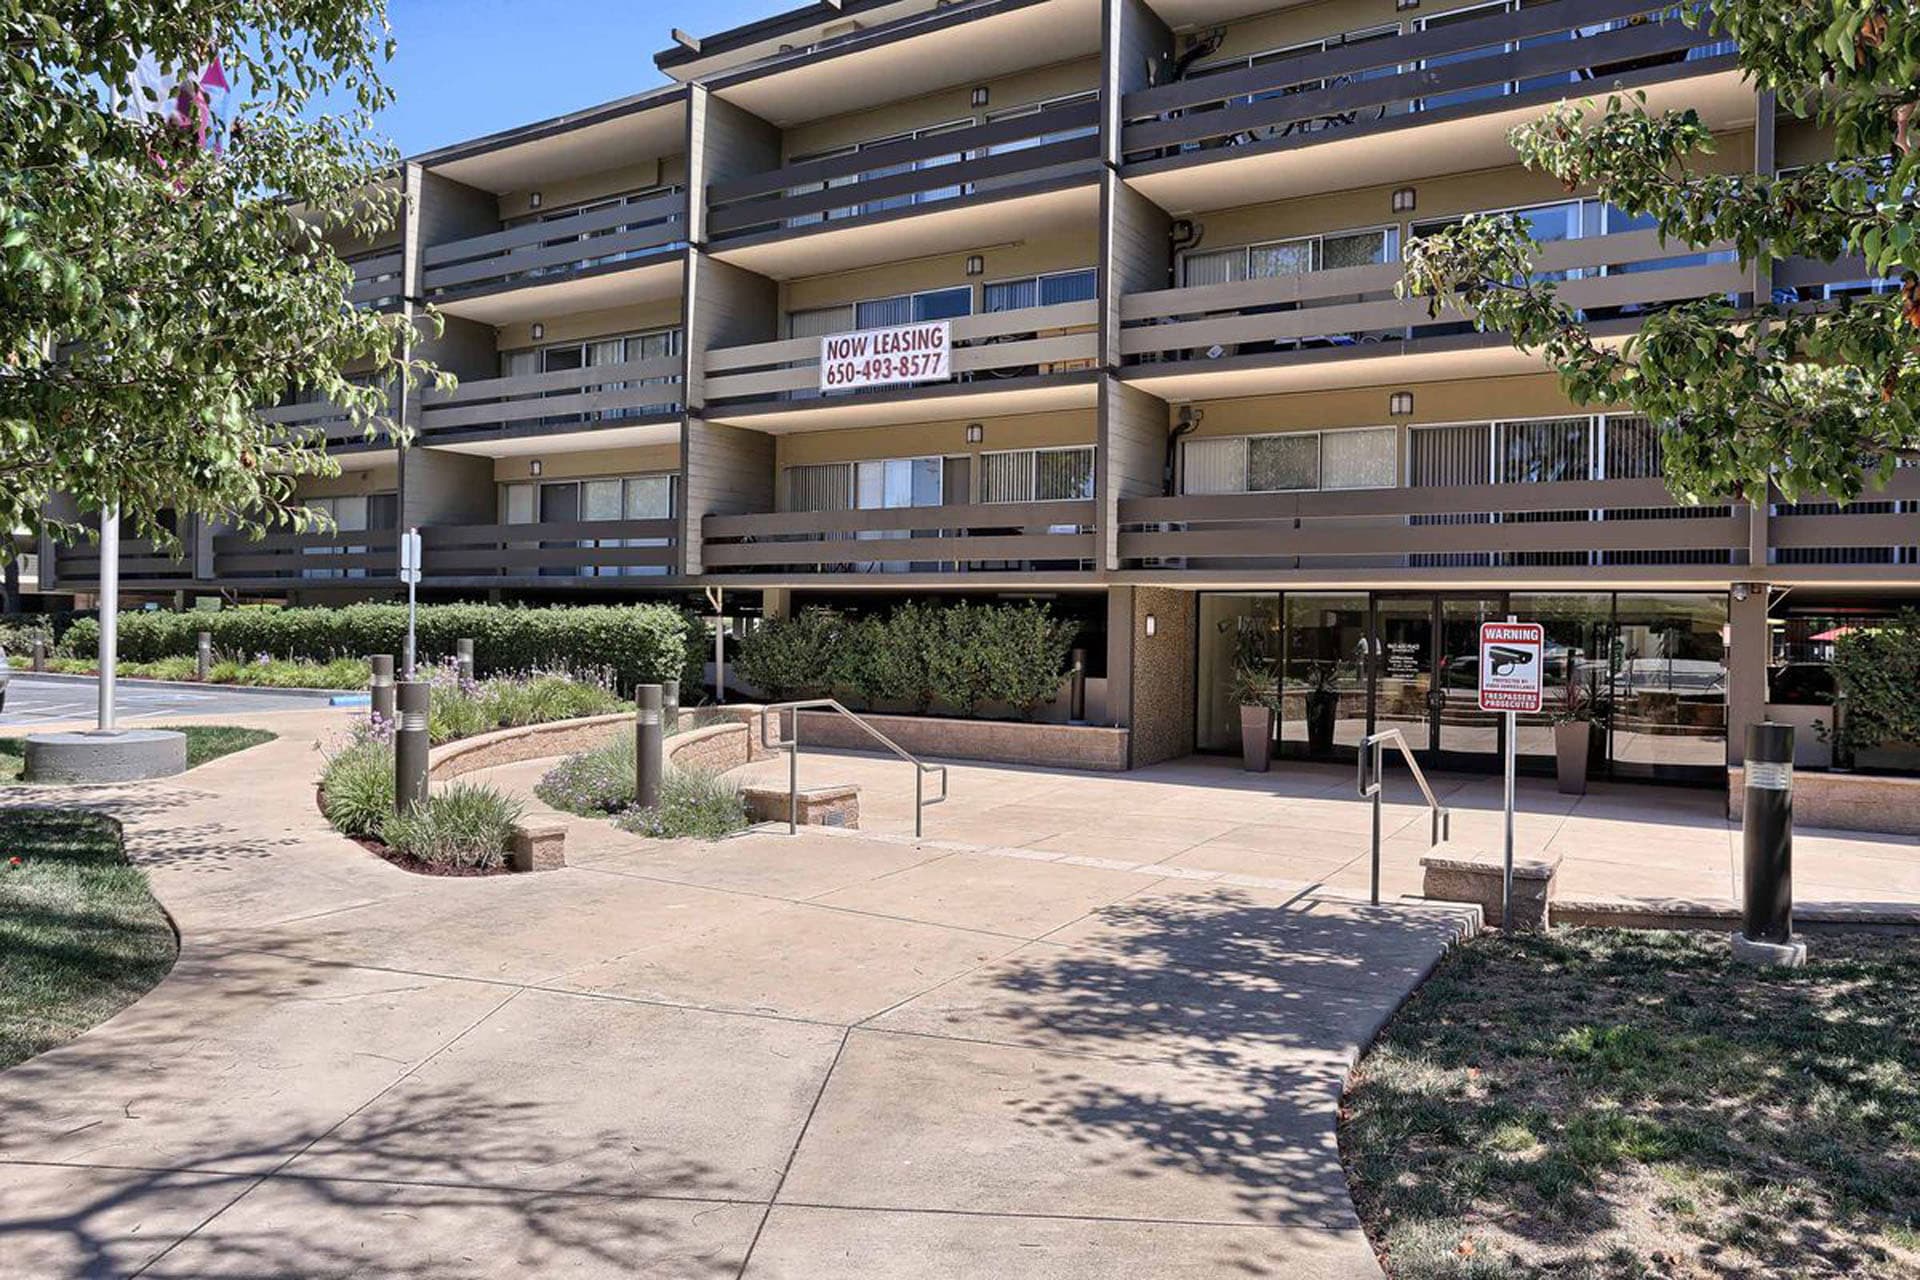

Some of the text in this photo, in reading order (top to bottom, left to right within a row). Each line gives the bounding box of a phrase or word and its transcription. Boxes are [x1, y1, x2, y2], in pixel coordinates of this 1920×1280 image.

[827, 327, 943, 360] NOW LEASING
[827, 352, 943, 385] 650-493-8577
[1484, 628, 1539, 641] WARNING
[1484, 692, 1537, 701] TRESPASSERS
[1484, 700, 1536, 709] PROSECUTED
